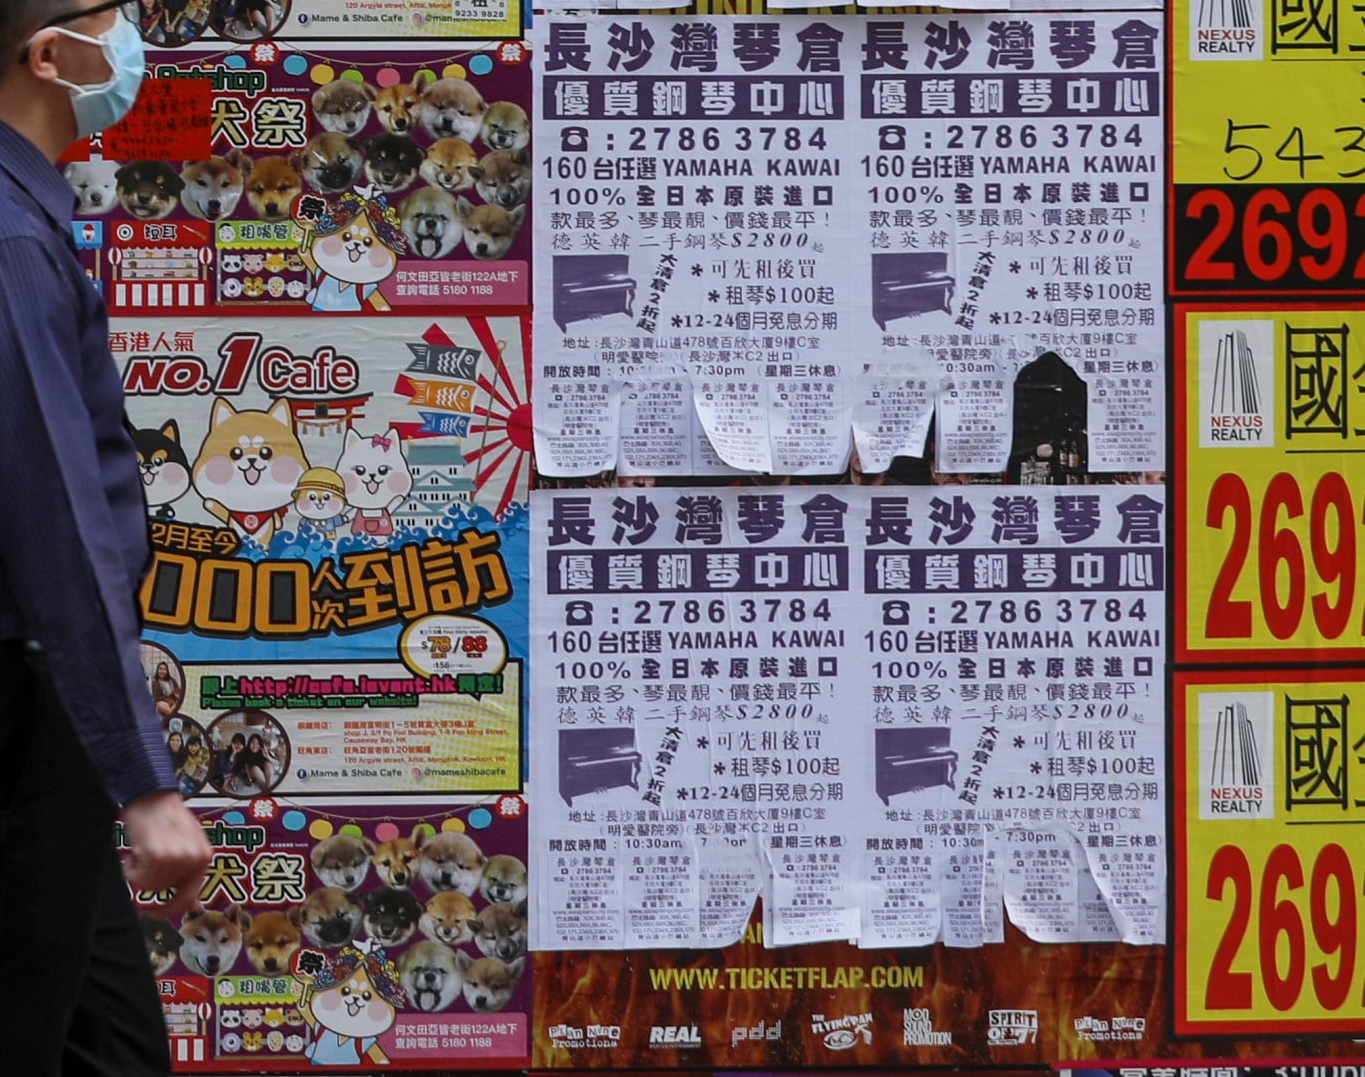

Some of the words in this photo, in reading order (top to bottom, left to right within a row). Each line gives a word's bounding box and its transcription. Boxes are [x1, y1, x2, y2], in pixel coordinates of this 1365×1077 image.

[1198, 30, 1255, 40] NEXUS
[1198, 41, 1256, 53] REALTY
[662, 158, 753, 177] YAMAHA
[768, 158, 841, 177] KAWAI
[443, 284, 466, 295] 5180
[470, 284, 493, 294] 1188
[261, 347, 358, 393] Cafe
[1210, 415, 1263, 427] NEXUS
[1210, 428, 1263, 441] REALTY
[548, 496, 849, 547] 長沙灣琴倉
[634, 599, 725, 624] 2786
[740, 598, 832, 623] 3784
[649, 966, 924, 991] WWW.TICKETFLAP.COM
[988, 1010, 1038, 1027] SPIRIT
[552, 1038, 617, 1048] Promotions
[650, 1026, 701, 1043] REAL
